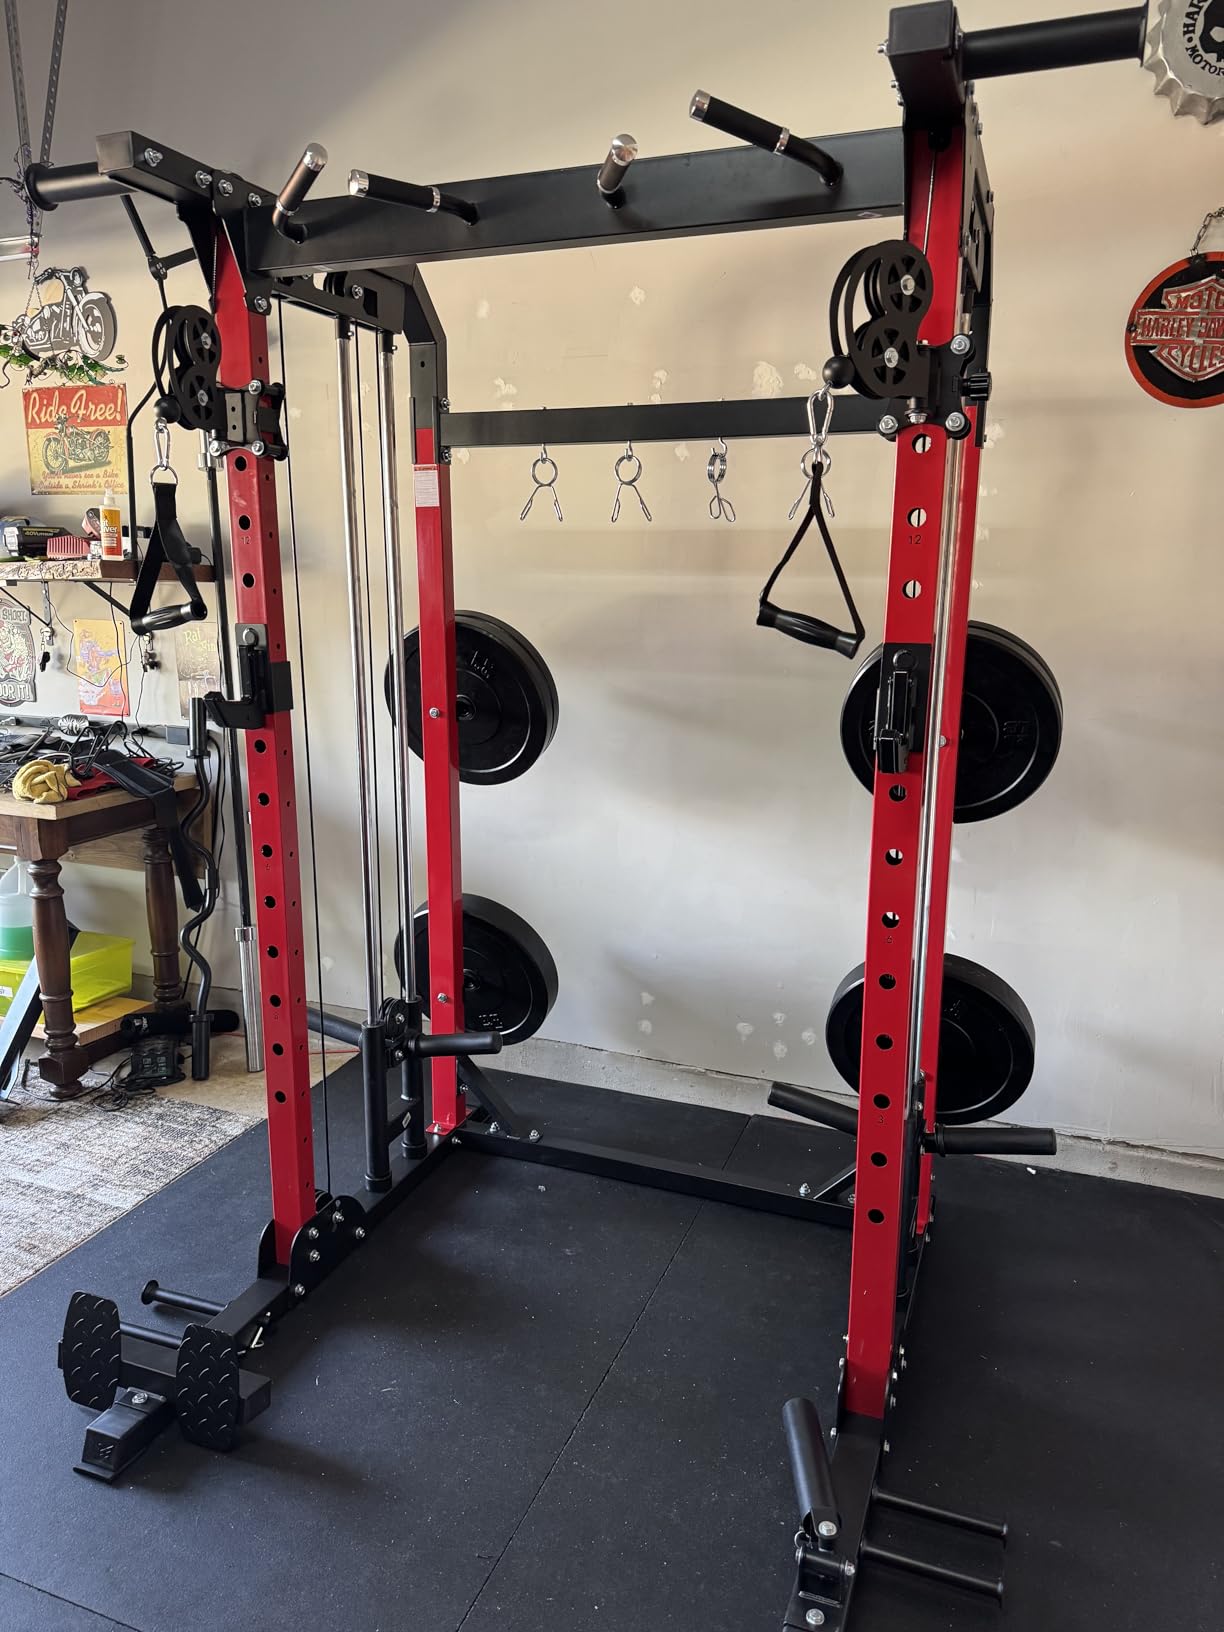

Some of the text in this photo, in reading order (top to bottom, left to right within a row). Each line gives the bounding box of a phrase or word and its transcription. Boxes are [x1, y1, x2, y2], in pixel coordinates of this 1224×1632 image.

[1141, 316, 1196, 338] HARLEY
[1167, 344, 1224, 373] CYCLE
[28, 388, 123, 424] Ride Free!
[102, 469, 119, 479] Bike
[71, 480, 102, 489] Shrink's
[240, 535, 251, 545] 12
[908, 535, 922, 545] 12
